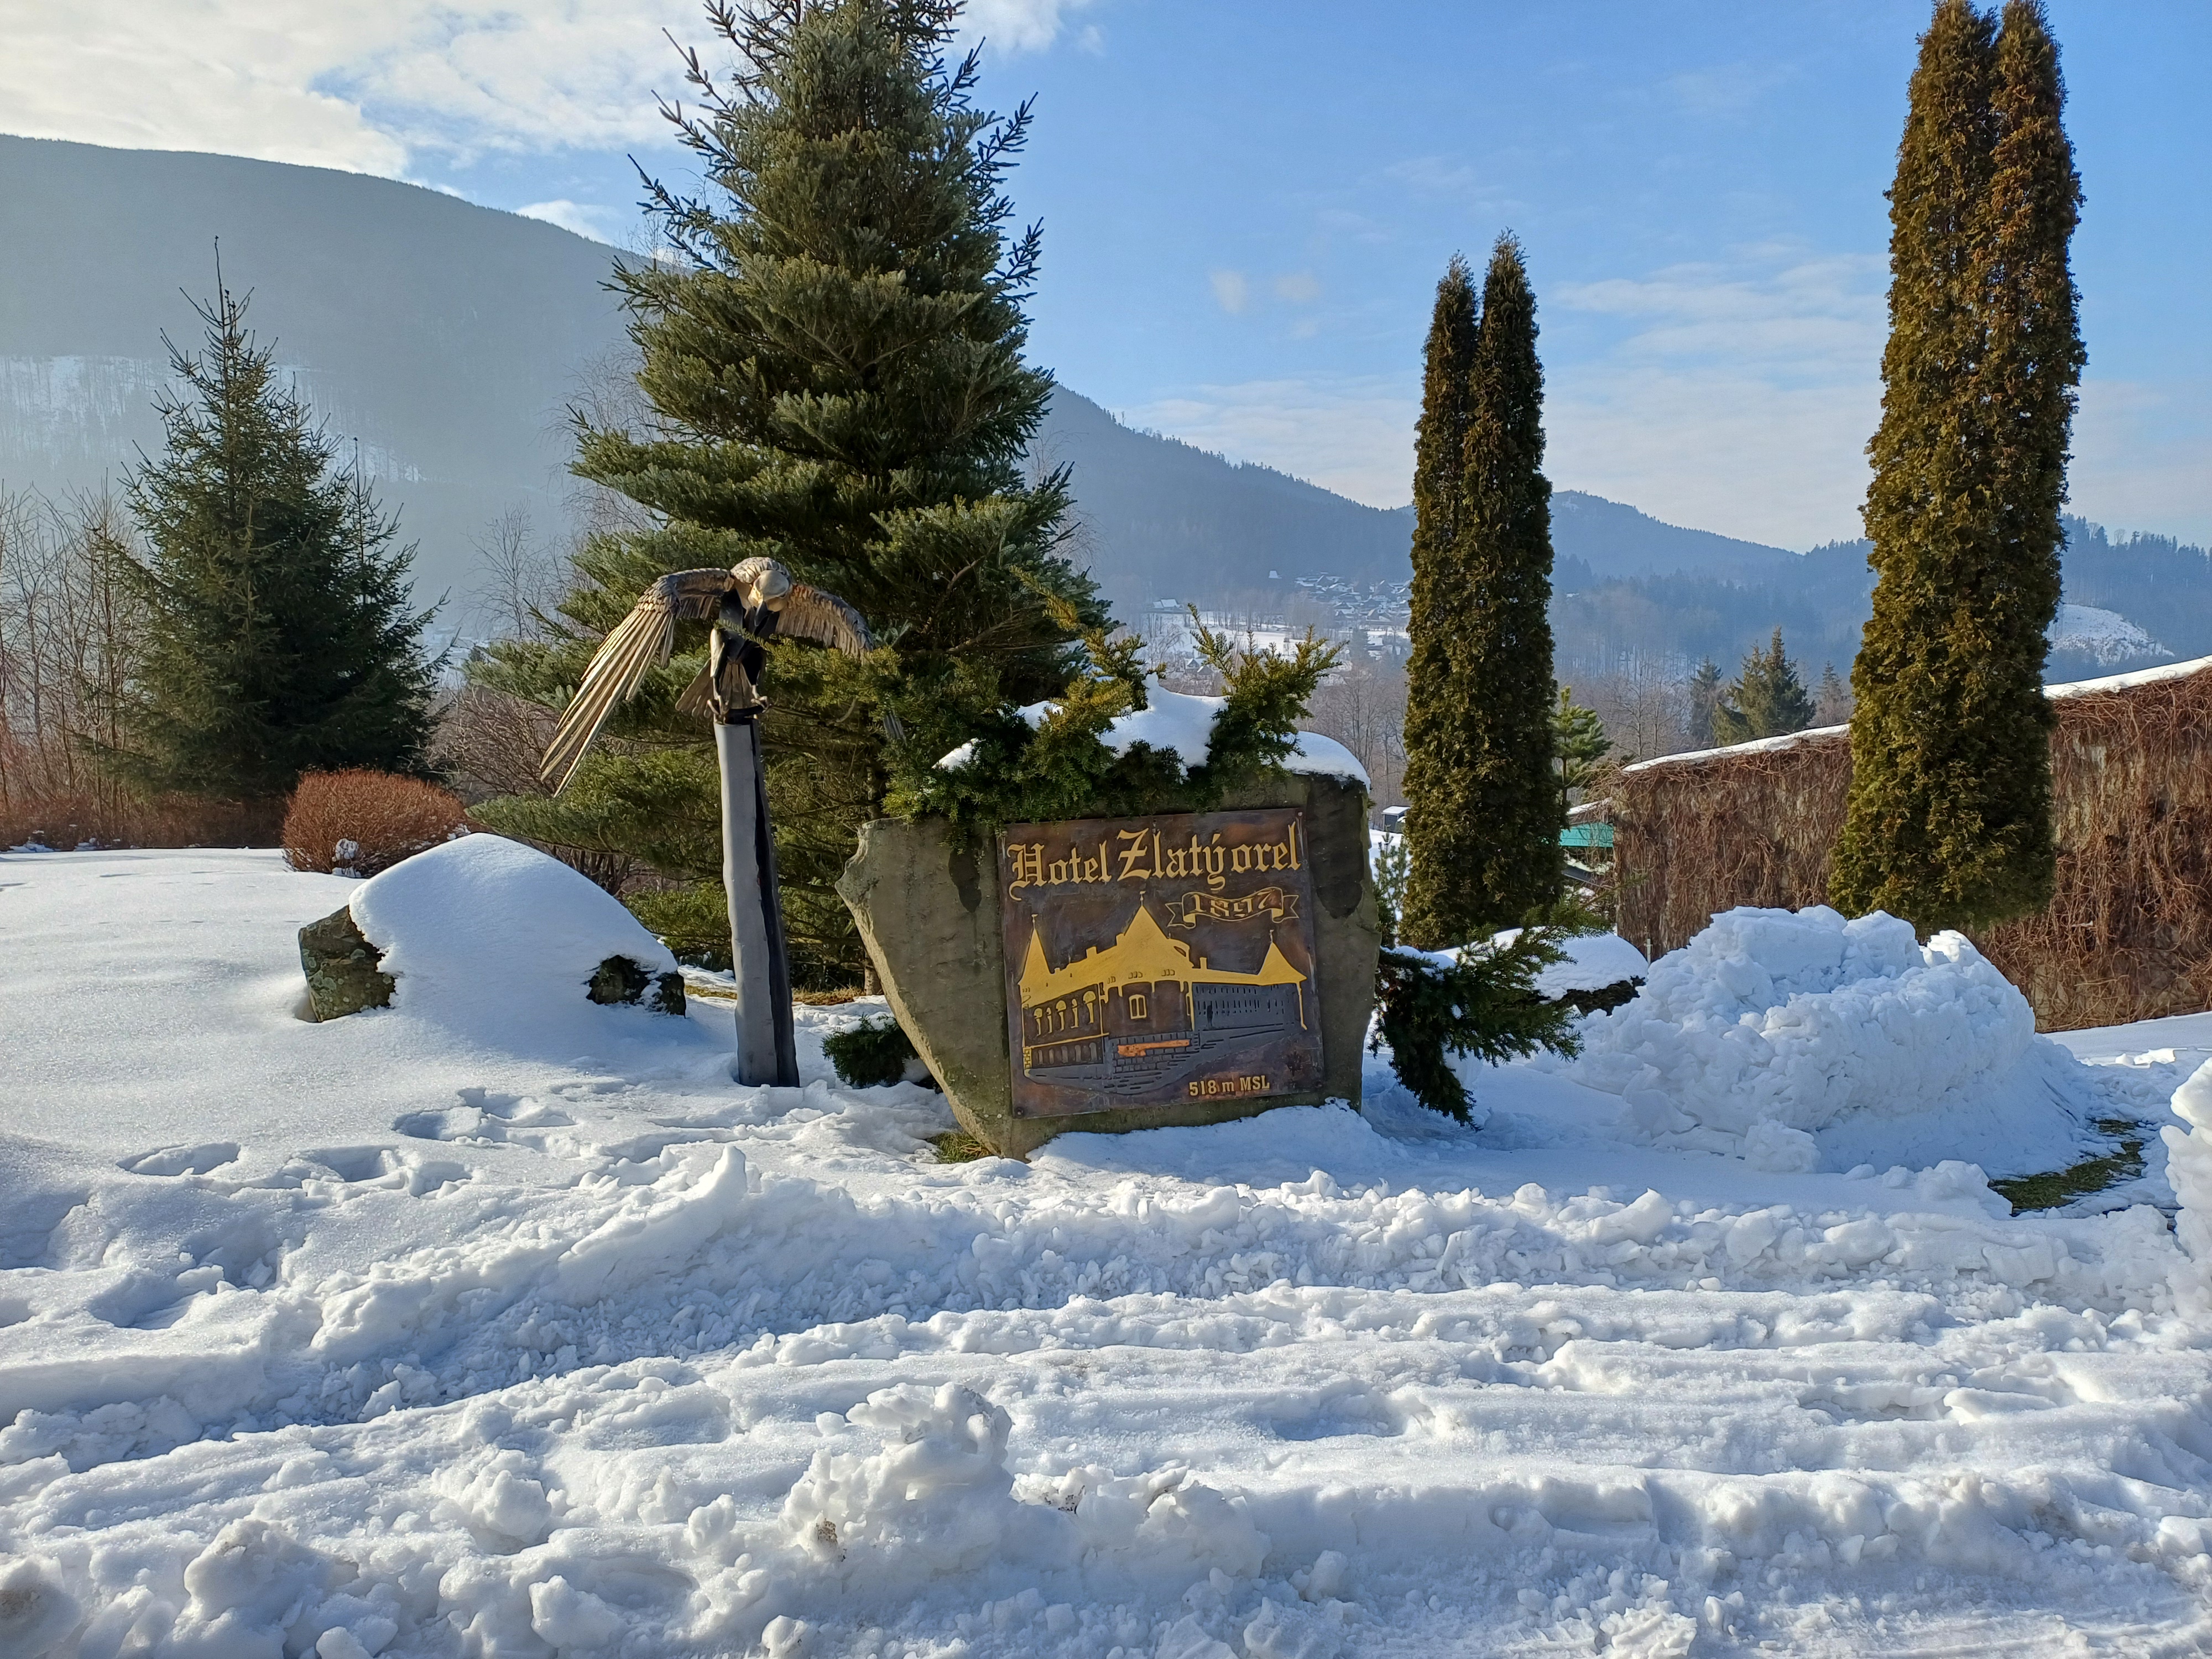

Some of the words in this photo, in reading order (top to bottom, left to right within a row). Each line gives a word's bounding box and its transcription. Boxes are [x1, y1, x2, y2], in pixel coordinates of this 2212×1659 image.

[1007, 839, 1112, 901] Hotel
[1117, 828, 1226, 890] Zlatý
[1231, 821, 1301, 873] orel
[1190, 889, 1275, 917] 1897
[1190, 1080, 1217, 1096] 518
[1222, 1081, 1235, 1093] m
[1239, 1075, 1270, 1091] MSL
